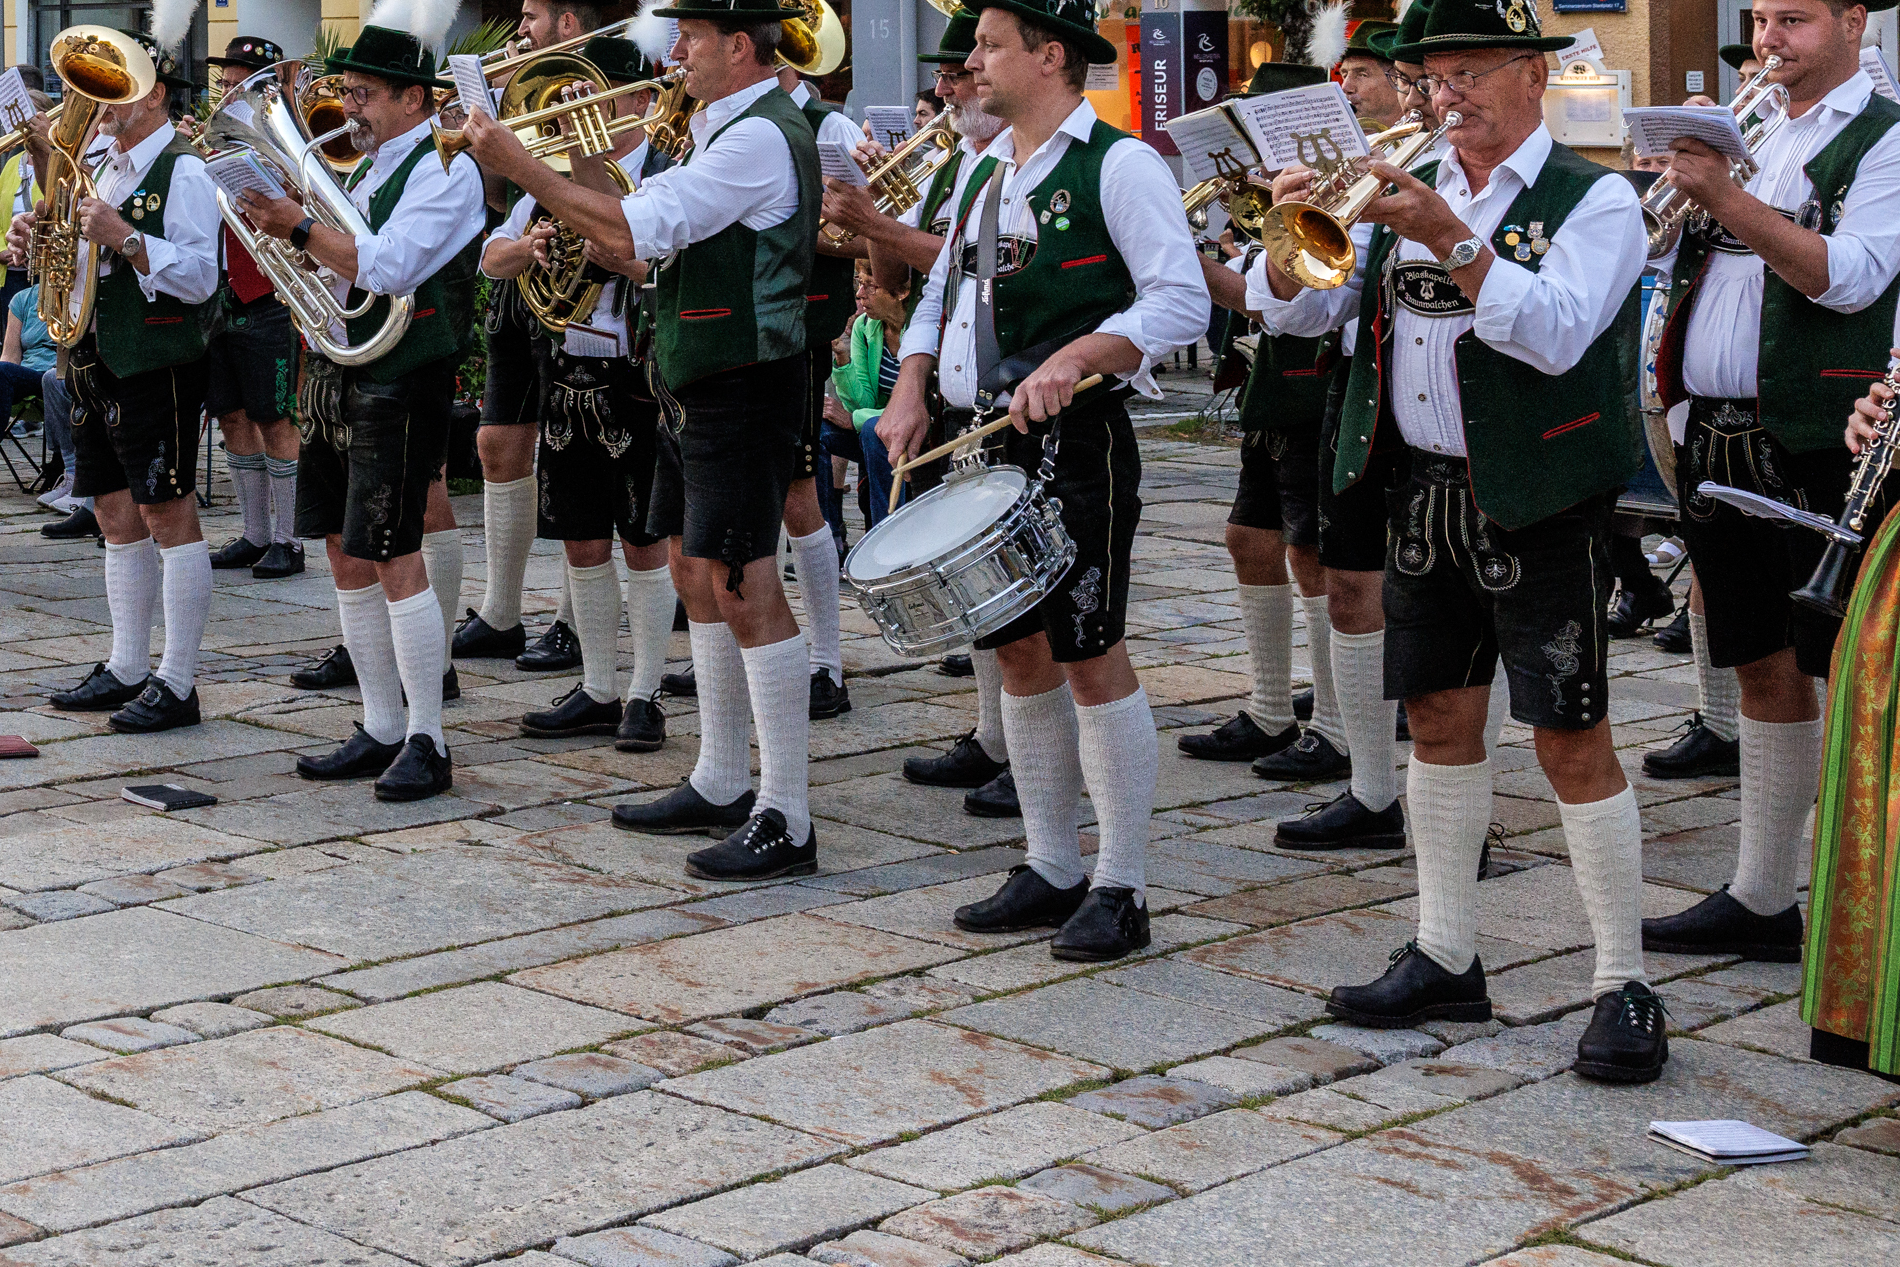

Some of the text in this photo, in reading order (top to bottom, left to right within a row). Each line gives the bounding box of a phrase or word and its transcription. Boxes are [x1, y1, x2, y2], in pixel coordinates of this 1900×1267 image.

[870, 19, 890, 39] 15
[1561, 50, 1580, 61] ERSTE
[1155, 59, 1167, 131] FRISEUR
